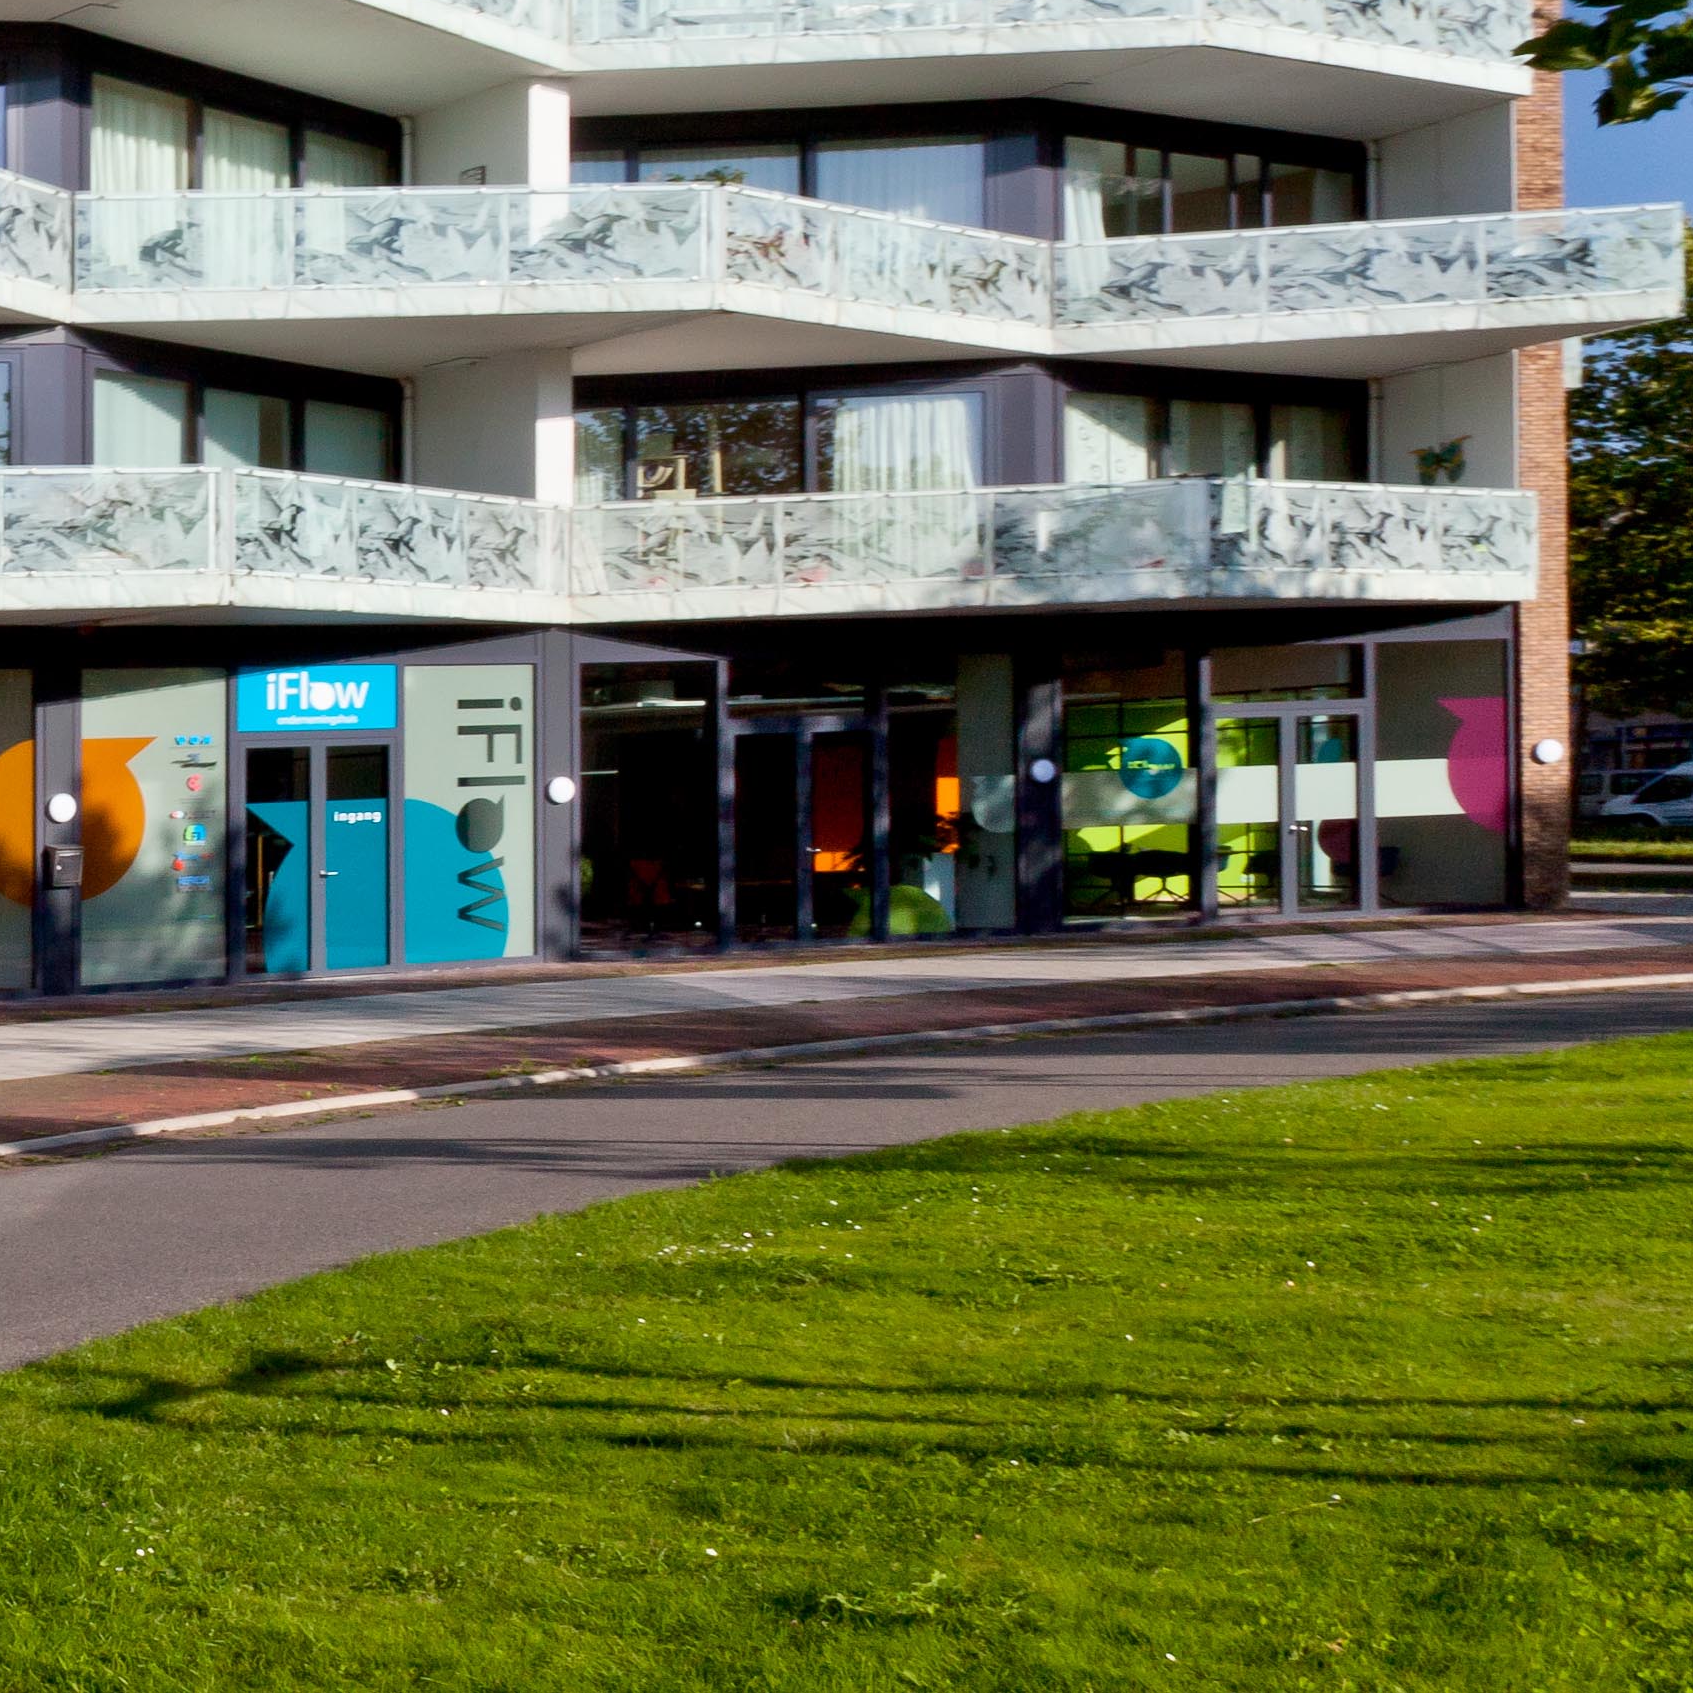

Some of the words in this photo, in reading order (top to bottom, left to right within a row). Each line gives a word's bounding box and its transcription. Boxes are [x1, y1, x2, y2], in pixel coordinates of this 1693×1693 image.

[266, 671, 370, 710] iFlow
[333, 811, 382, 824] ingang
[456, 697, 526, 931] iFlow
